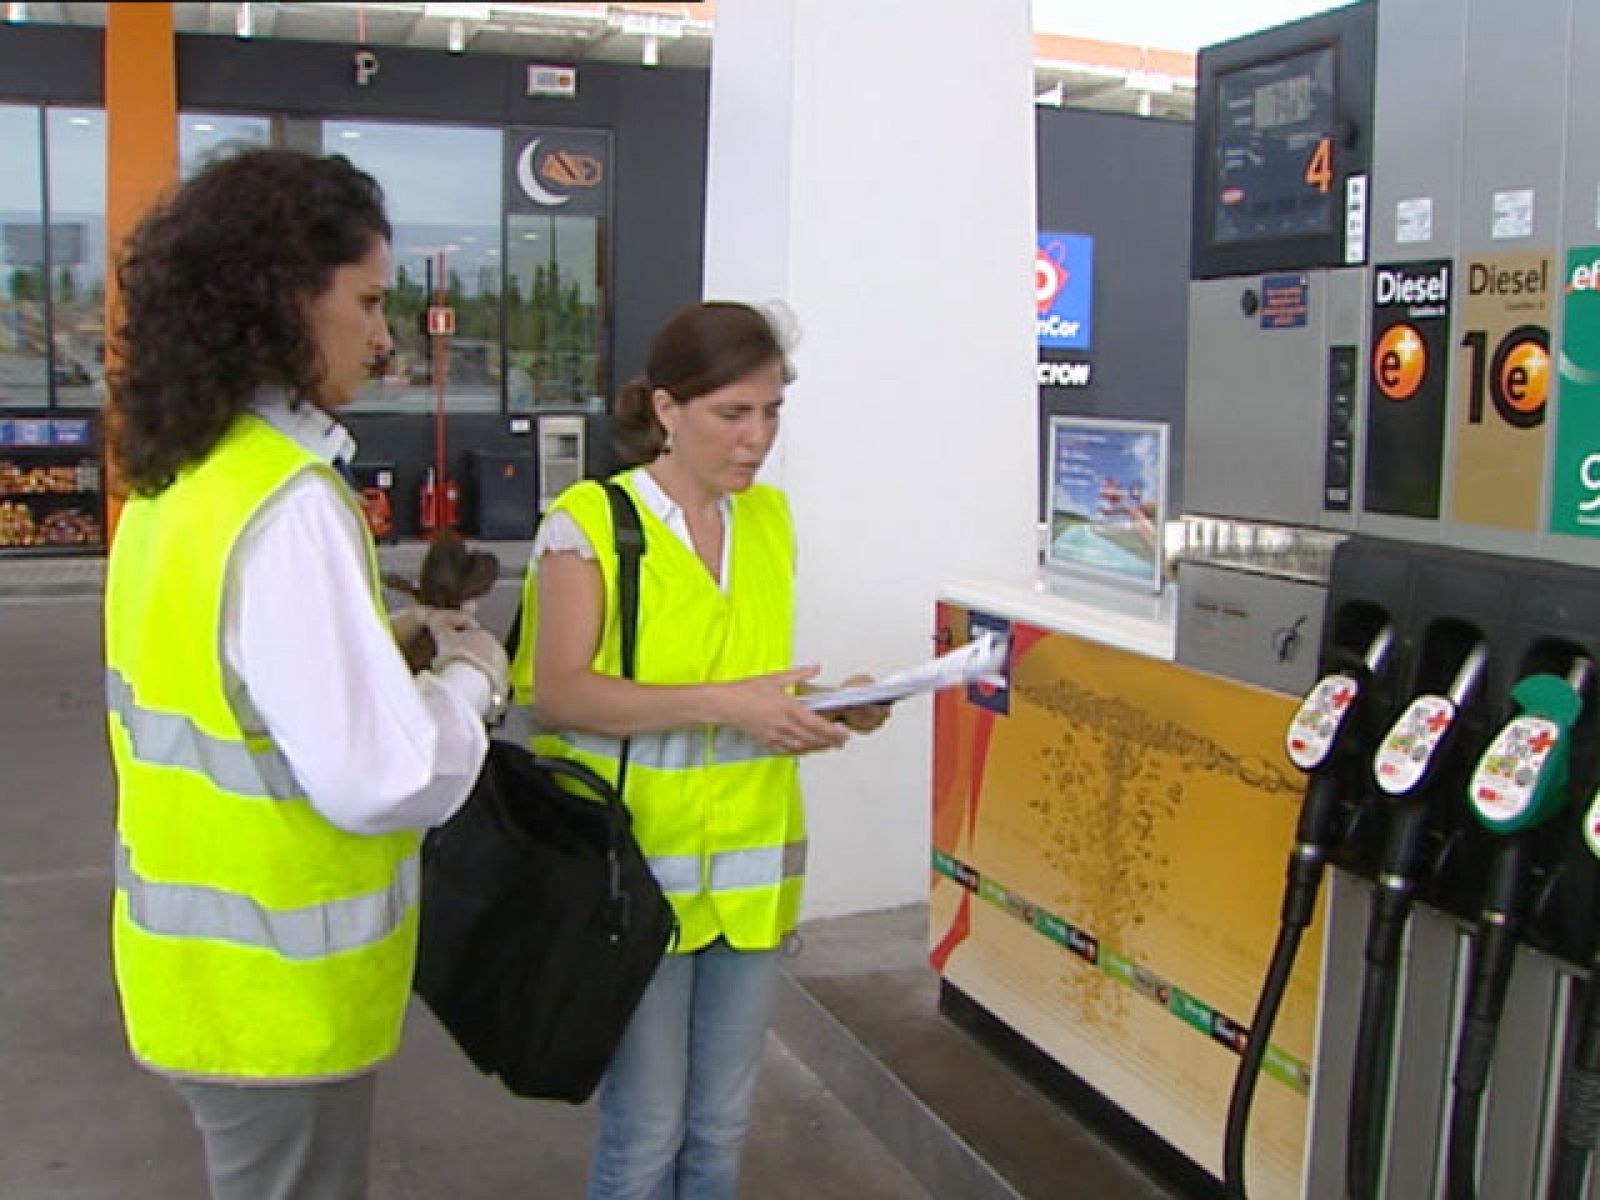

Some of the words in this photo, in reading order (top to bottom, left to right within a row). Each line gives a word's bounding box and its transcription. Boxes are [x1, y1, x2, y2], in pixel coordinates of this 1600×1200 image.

[1305, 138, 1334, 194] 4
[1377, 267, 1447, 303] Diesel
[1469, 260, 1548, 295] Diesel
